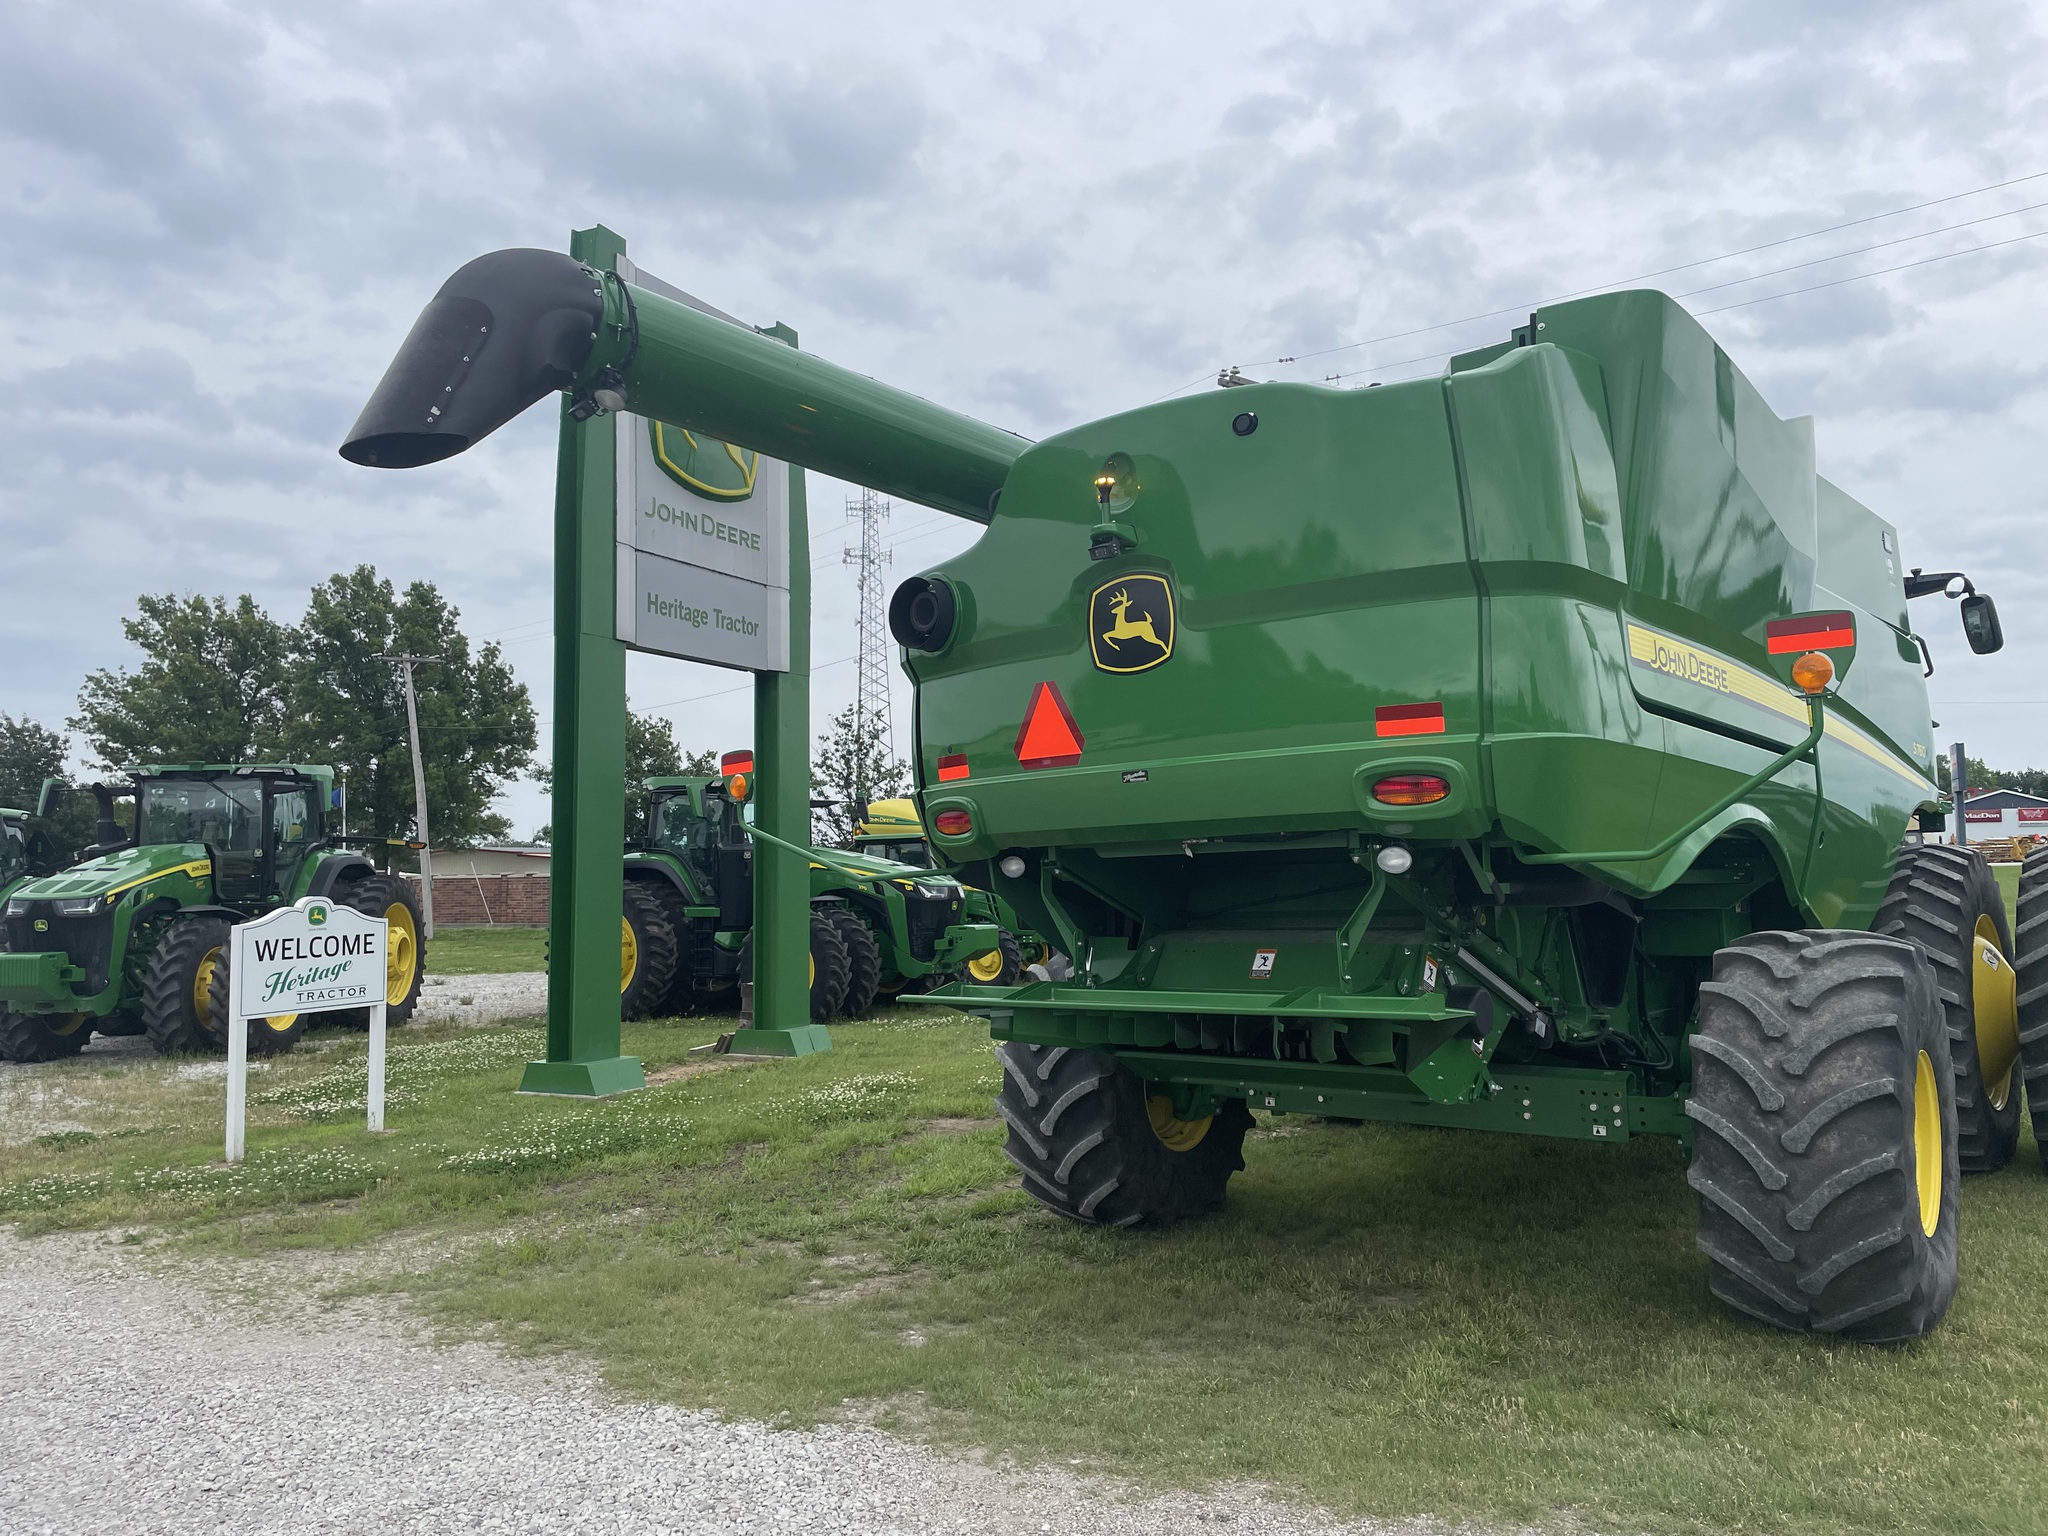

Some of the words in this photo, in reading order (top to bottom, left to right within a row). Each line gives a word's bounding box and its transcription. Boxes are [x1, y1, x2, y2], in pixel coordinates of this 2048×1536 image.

[644, 497, 698, 533] JOHN
[701, 513, 761, 551] DEERE
[647, 592, 709, 628] Heritage
[713, 608, 759, 637] Tractor
[1650, 640, 1687, 676] JOHN
[1688, 652, 1729, 690] DEERE
[254, 933, 376, 962] WELCOME
[261, 959, 353, 1003] Heritage
[296, 987, 367, 1002] TRACTOR
